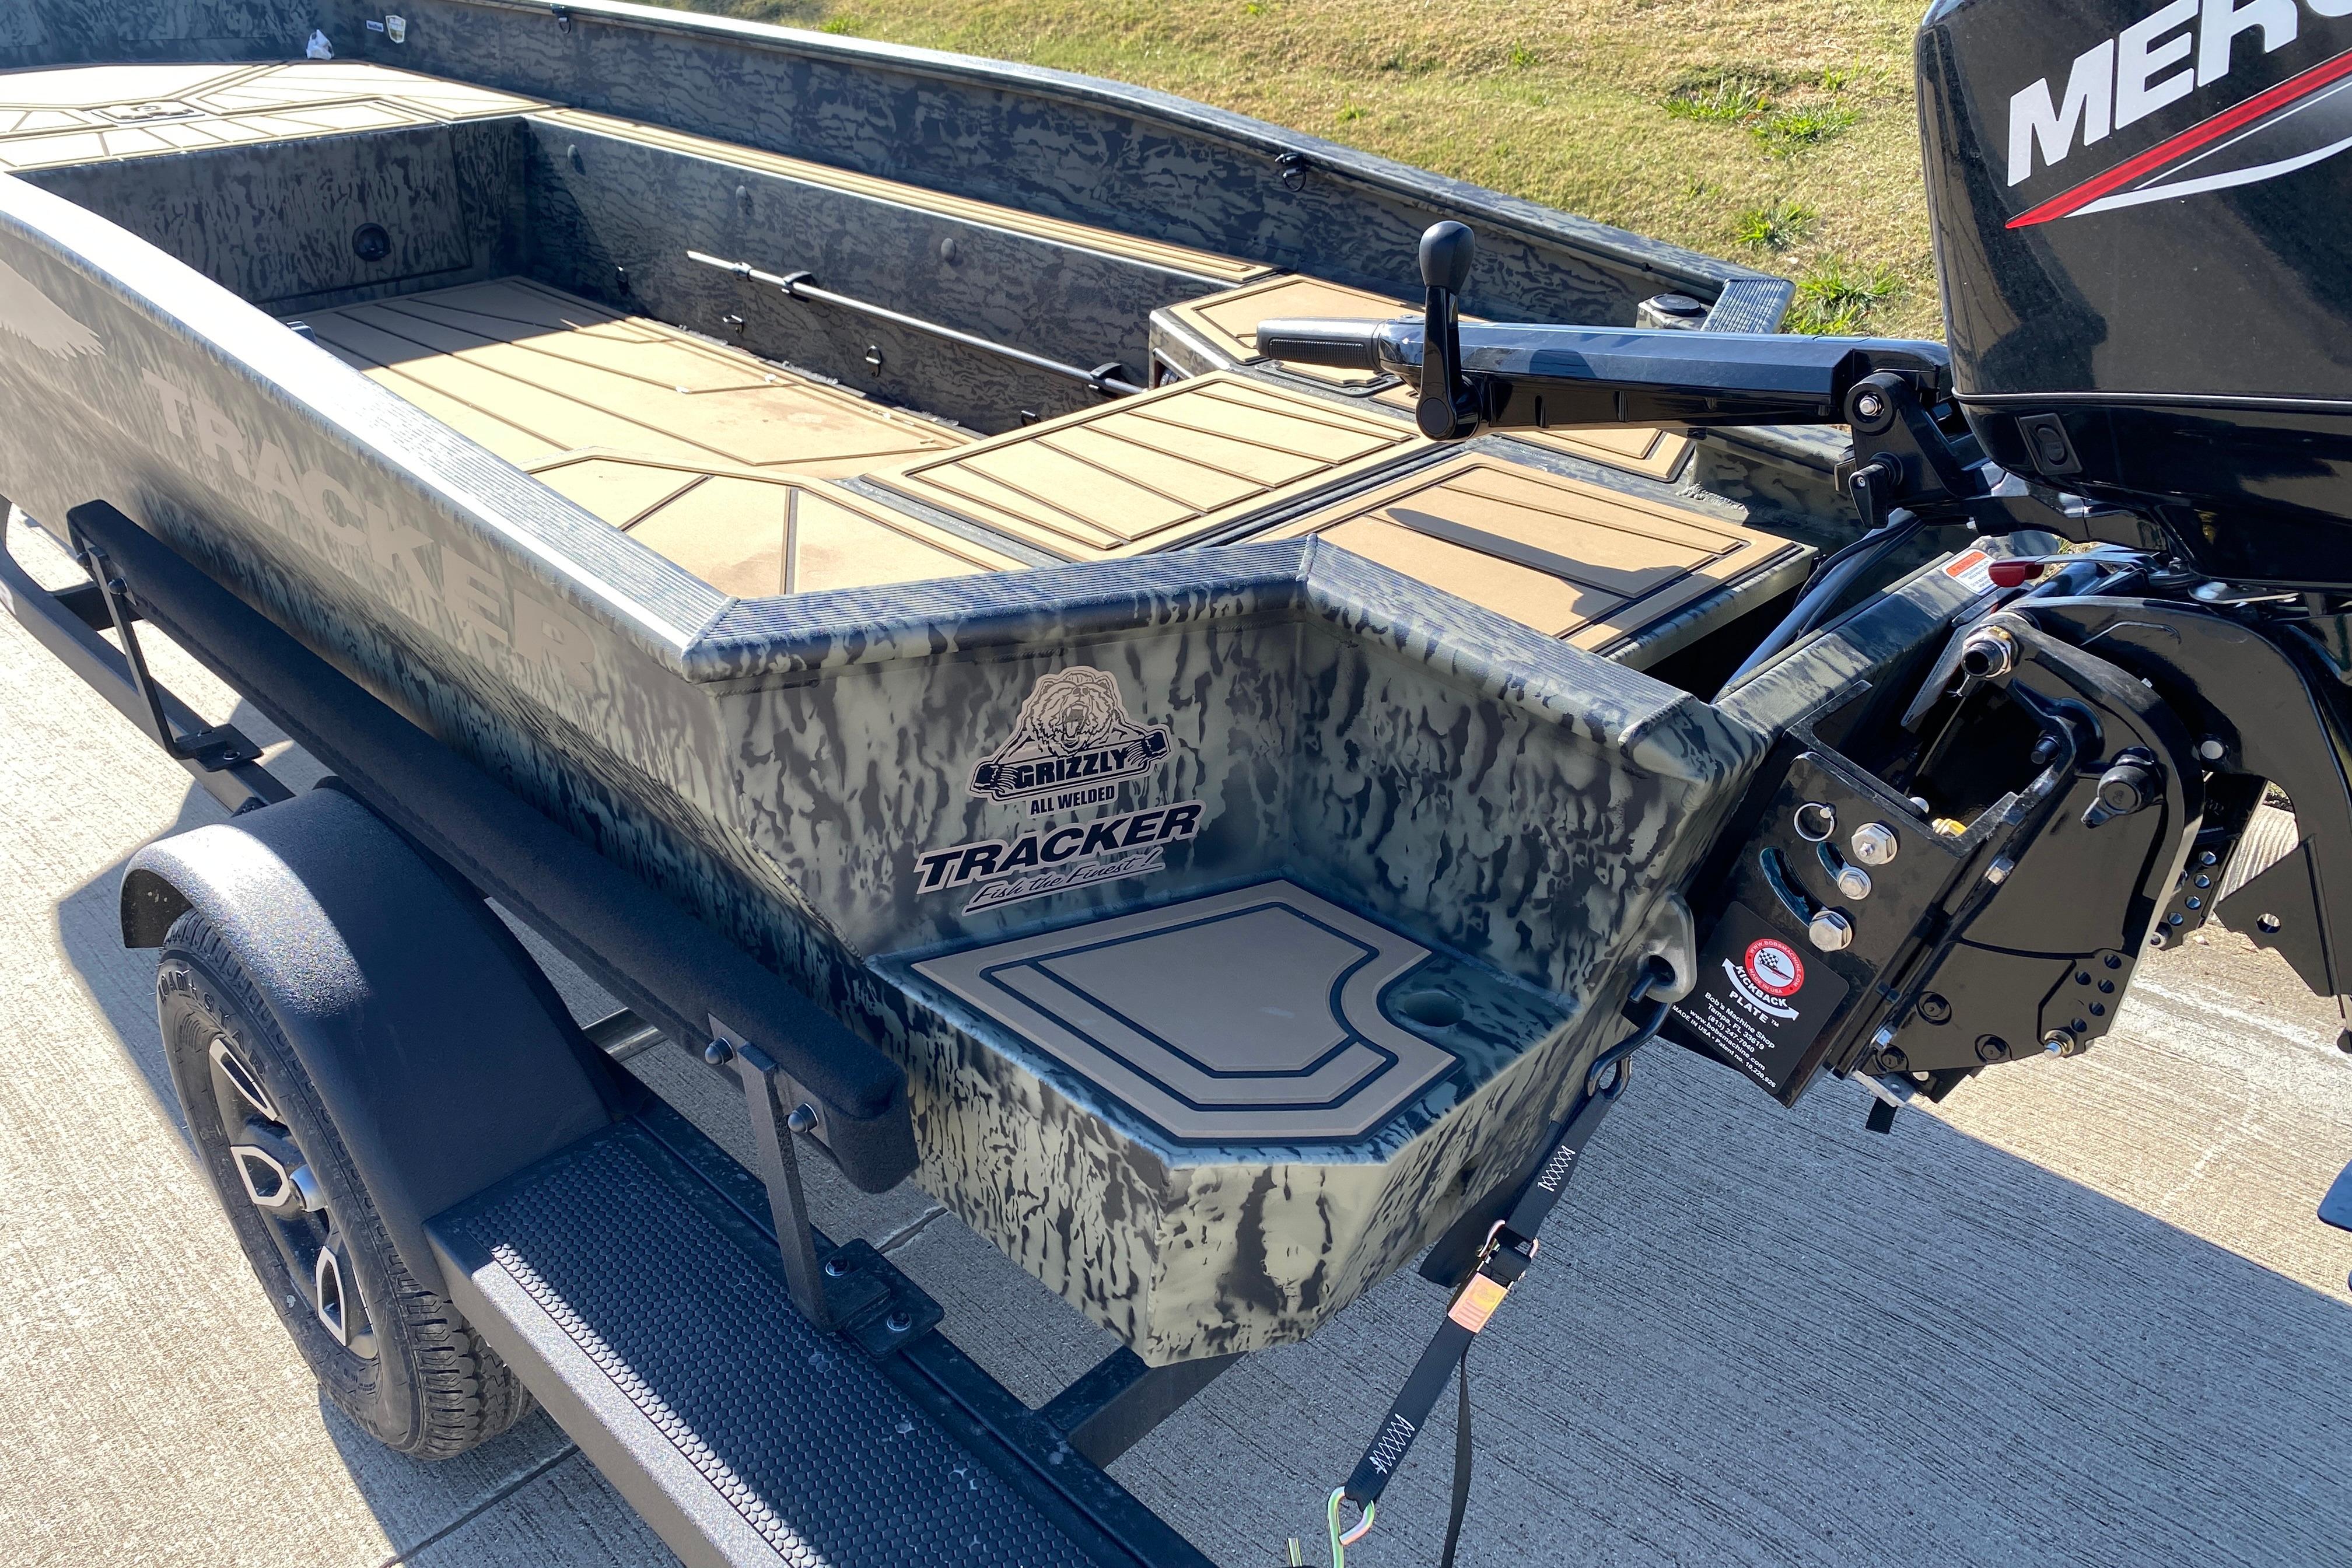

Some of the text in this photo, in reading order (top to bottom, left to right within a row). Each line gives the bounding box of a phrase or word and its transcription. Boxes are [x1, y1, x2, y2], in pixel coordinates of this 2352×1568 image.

[2007, 0, 2352, 187] MER
[141, 367, 595, 693] TRACKER
[1016, 747, 1128, 789] GRIZZLY
[1030, 786, 1115, 816] ALL WELDED
[922, 805, 1202, 888] TRACKER
[972, 883, 1024, 904] Fish
[1029, 874, 1063, 891] the
[1735, 965, 1788, 1007] KICKBACK
[1749, 941, 1801, 987] WWW.BOBSMACHINE.COM
[1749, 968, 1762, 985] MADE
[158, 970, 187, 1006] LOAD
[1729, 991, 1769, 1023] PLATE
[1690, 1010, 1765, 1070] www.bobsmachine.com
[1704, 992, 1775, 1049] Bob's Machine Shop
[1707, 1003, 1765, 1050] Tampa, FL 33619
[1708, 1015, 1755, 1052] (813) 247-7040
[1672, 1005, 1691, 1021] MADE
[1698, 1024, 1711, 1038] USA
[1715, 1038, 1734, 1056] Patent
[1734, 1054, 1744, 1063] no.
[1745, 1062, 1776, 1088] 10,220,926
